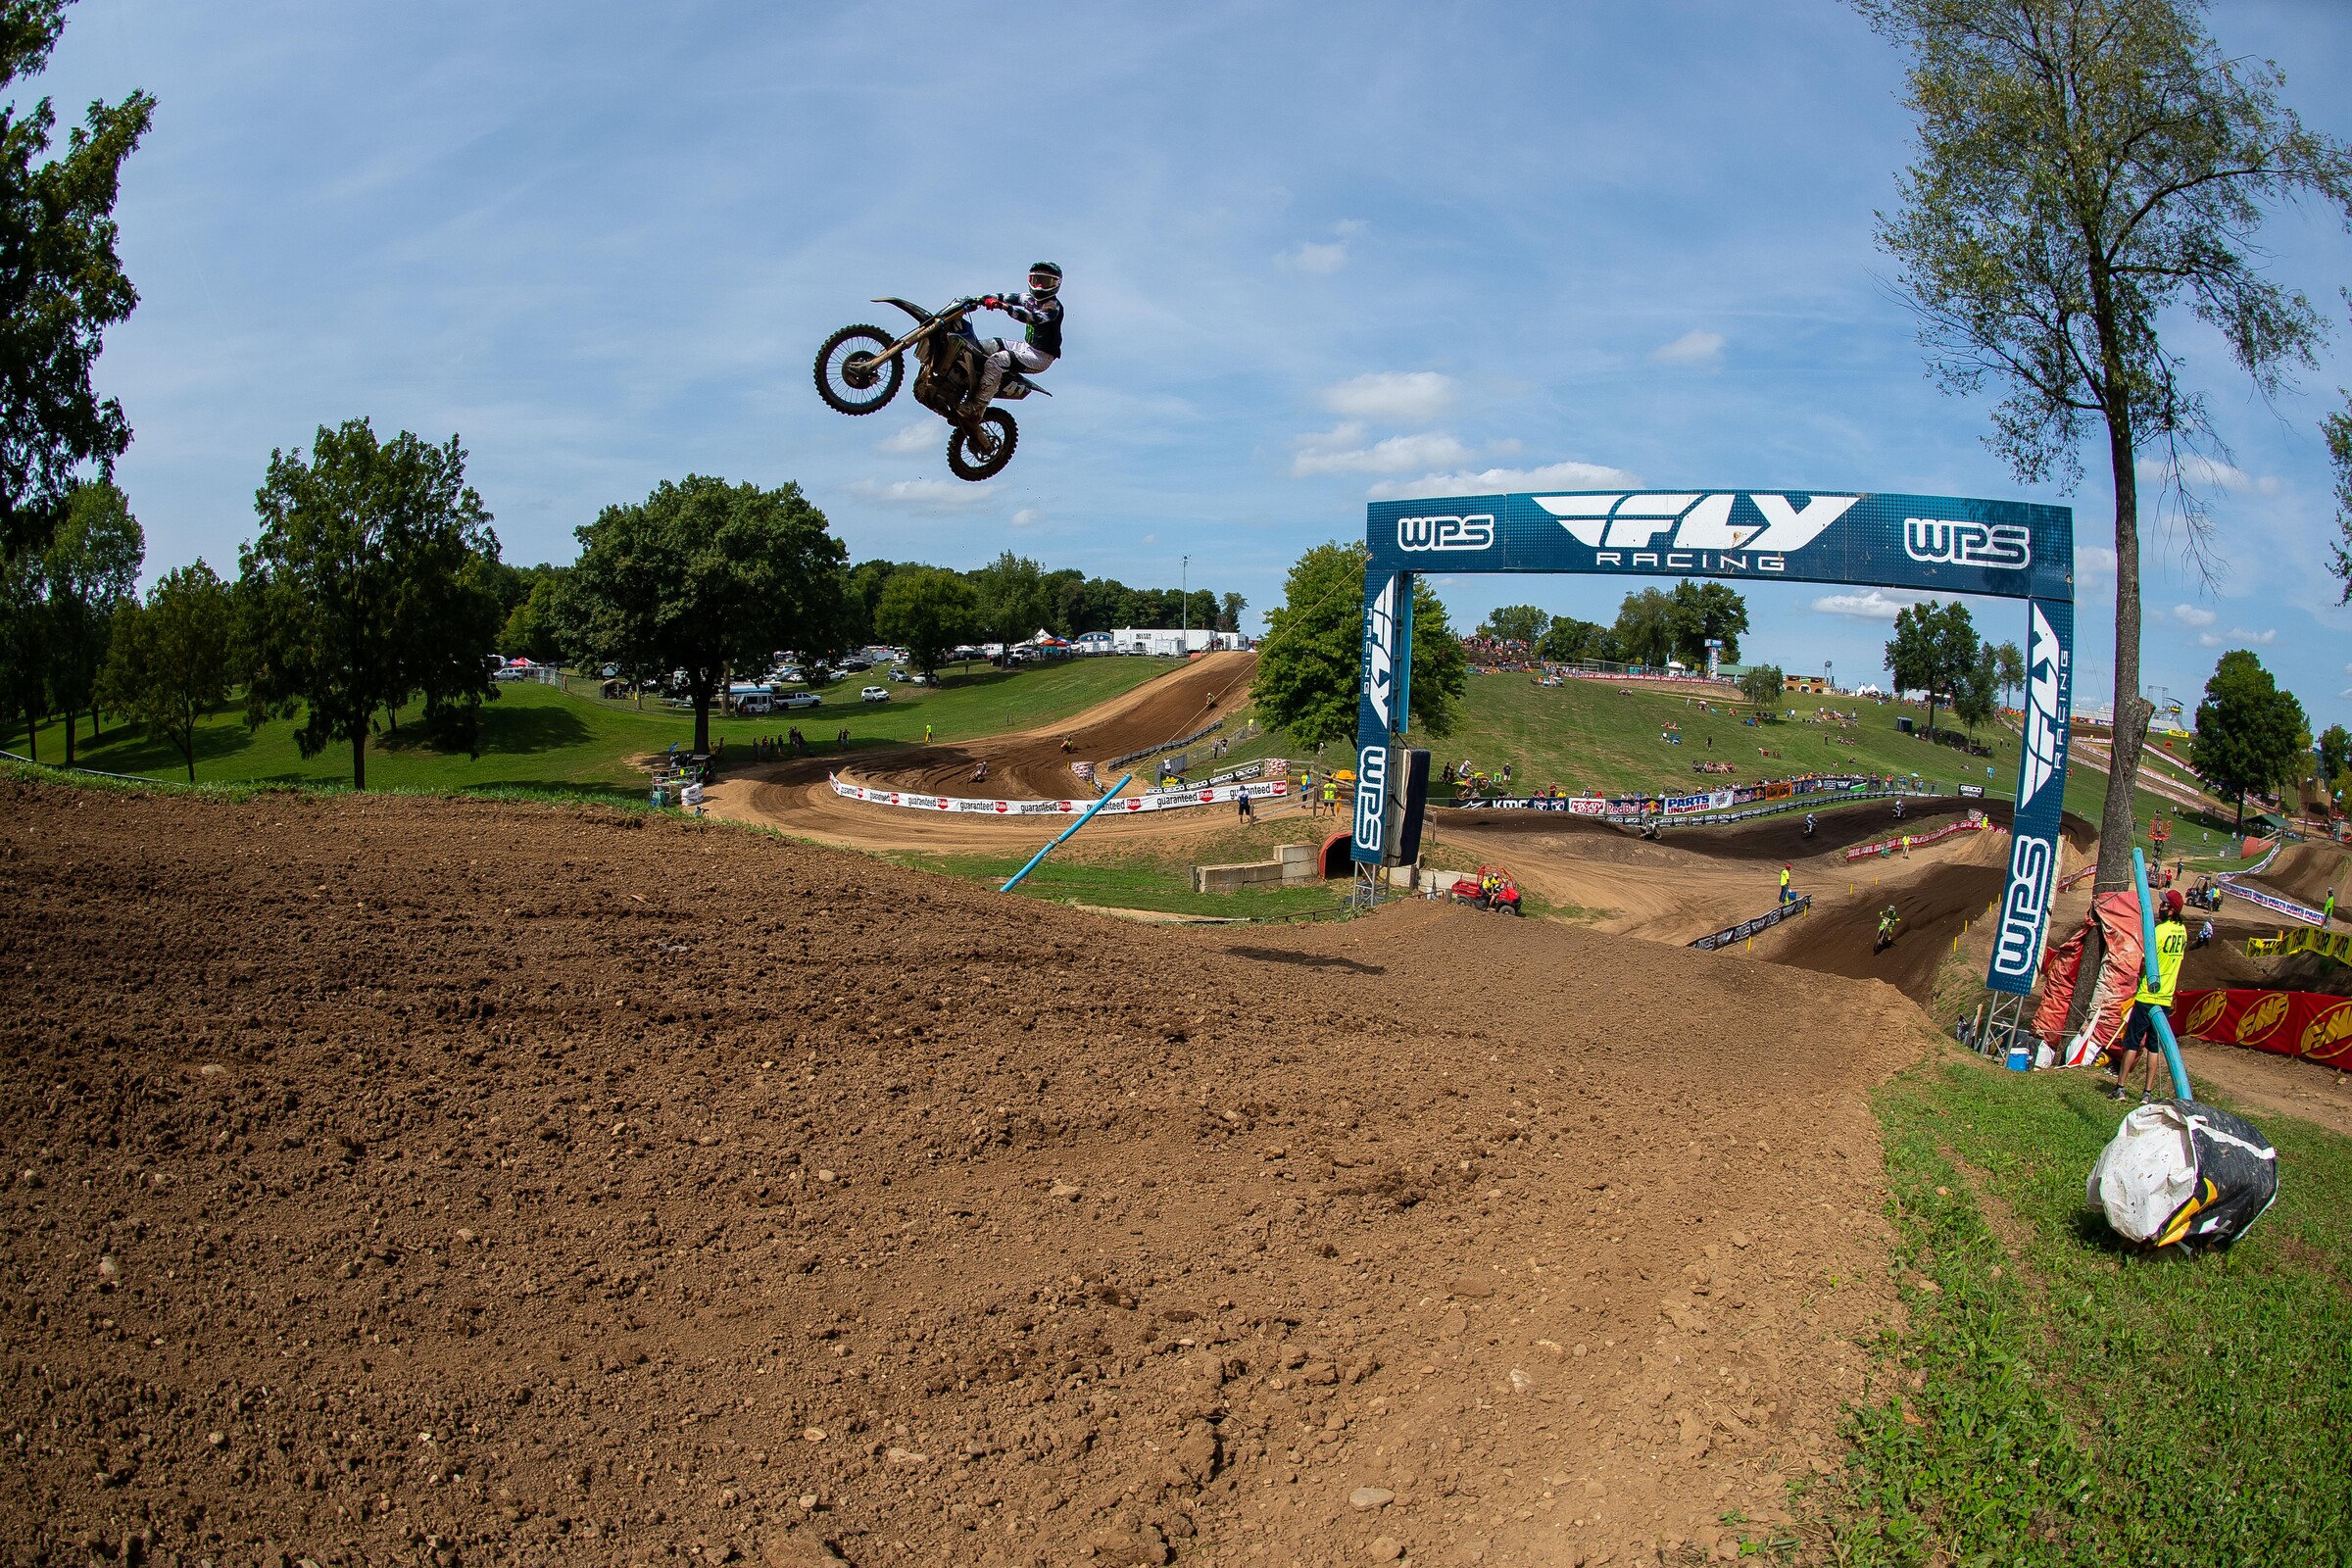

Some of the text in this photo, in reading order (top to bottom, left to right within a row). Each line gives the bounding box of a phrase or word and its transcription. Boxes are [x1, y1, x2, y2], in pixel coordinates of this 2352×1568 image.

[1397, 514, 1494, 552] WPS
[1904, 517, 2031, 570] WPS
[1595, 551, 1786, 571] RACING
[1363, 607, 1374, 697] RACING
[2054, 649, 2068, 770] RACING
[960, 801, 994, 811] guaranteed
[1020, 803, 1057, 814] guaranteed
[1157, 793, 1198, 808] guaranteed
[1354, 745, 1387, 851] WPS
[1607, 802, 1641, 813] Red Bull
[1668, 795, 1710, 807] PARTS
[1668, 804, 1710, 813] UNLIMITED
[1993, 834, 2052, 976] WPS
[2185, 991, 2227, 1035] FMF
[2235, 993, 2289, 1043] FMF
[2301, 1002, 2352, 1054] FM
